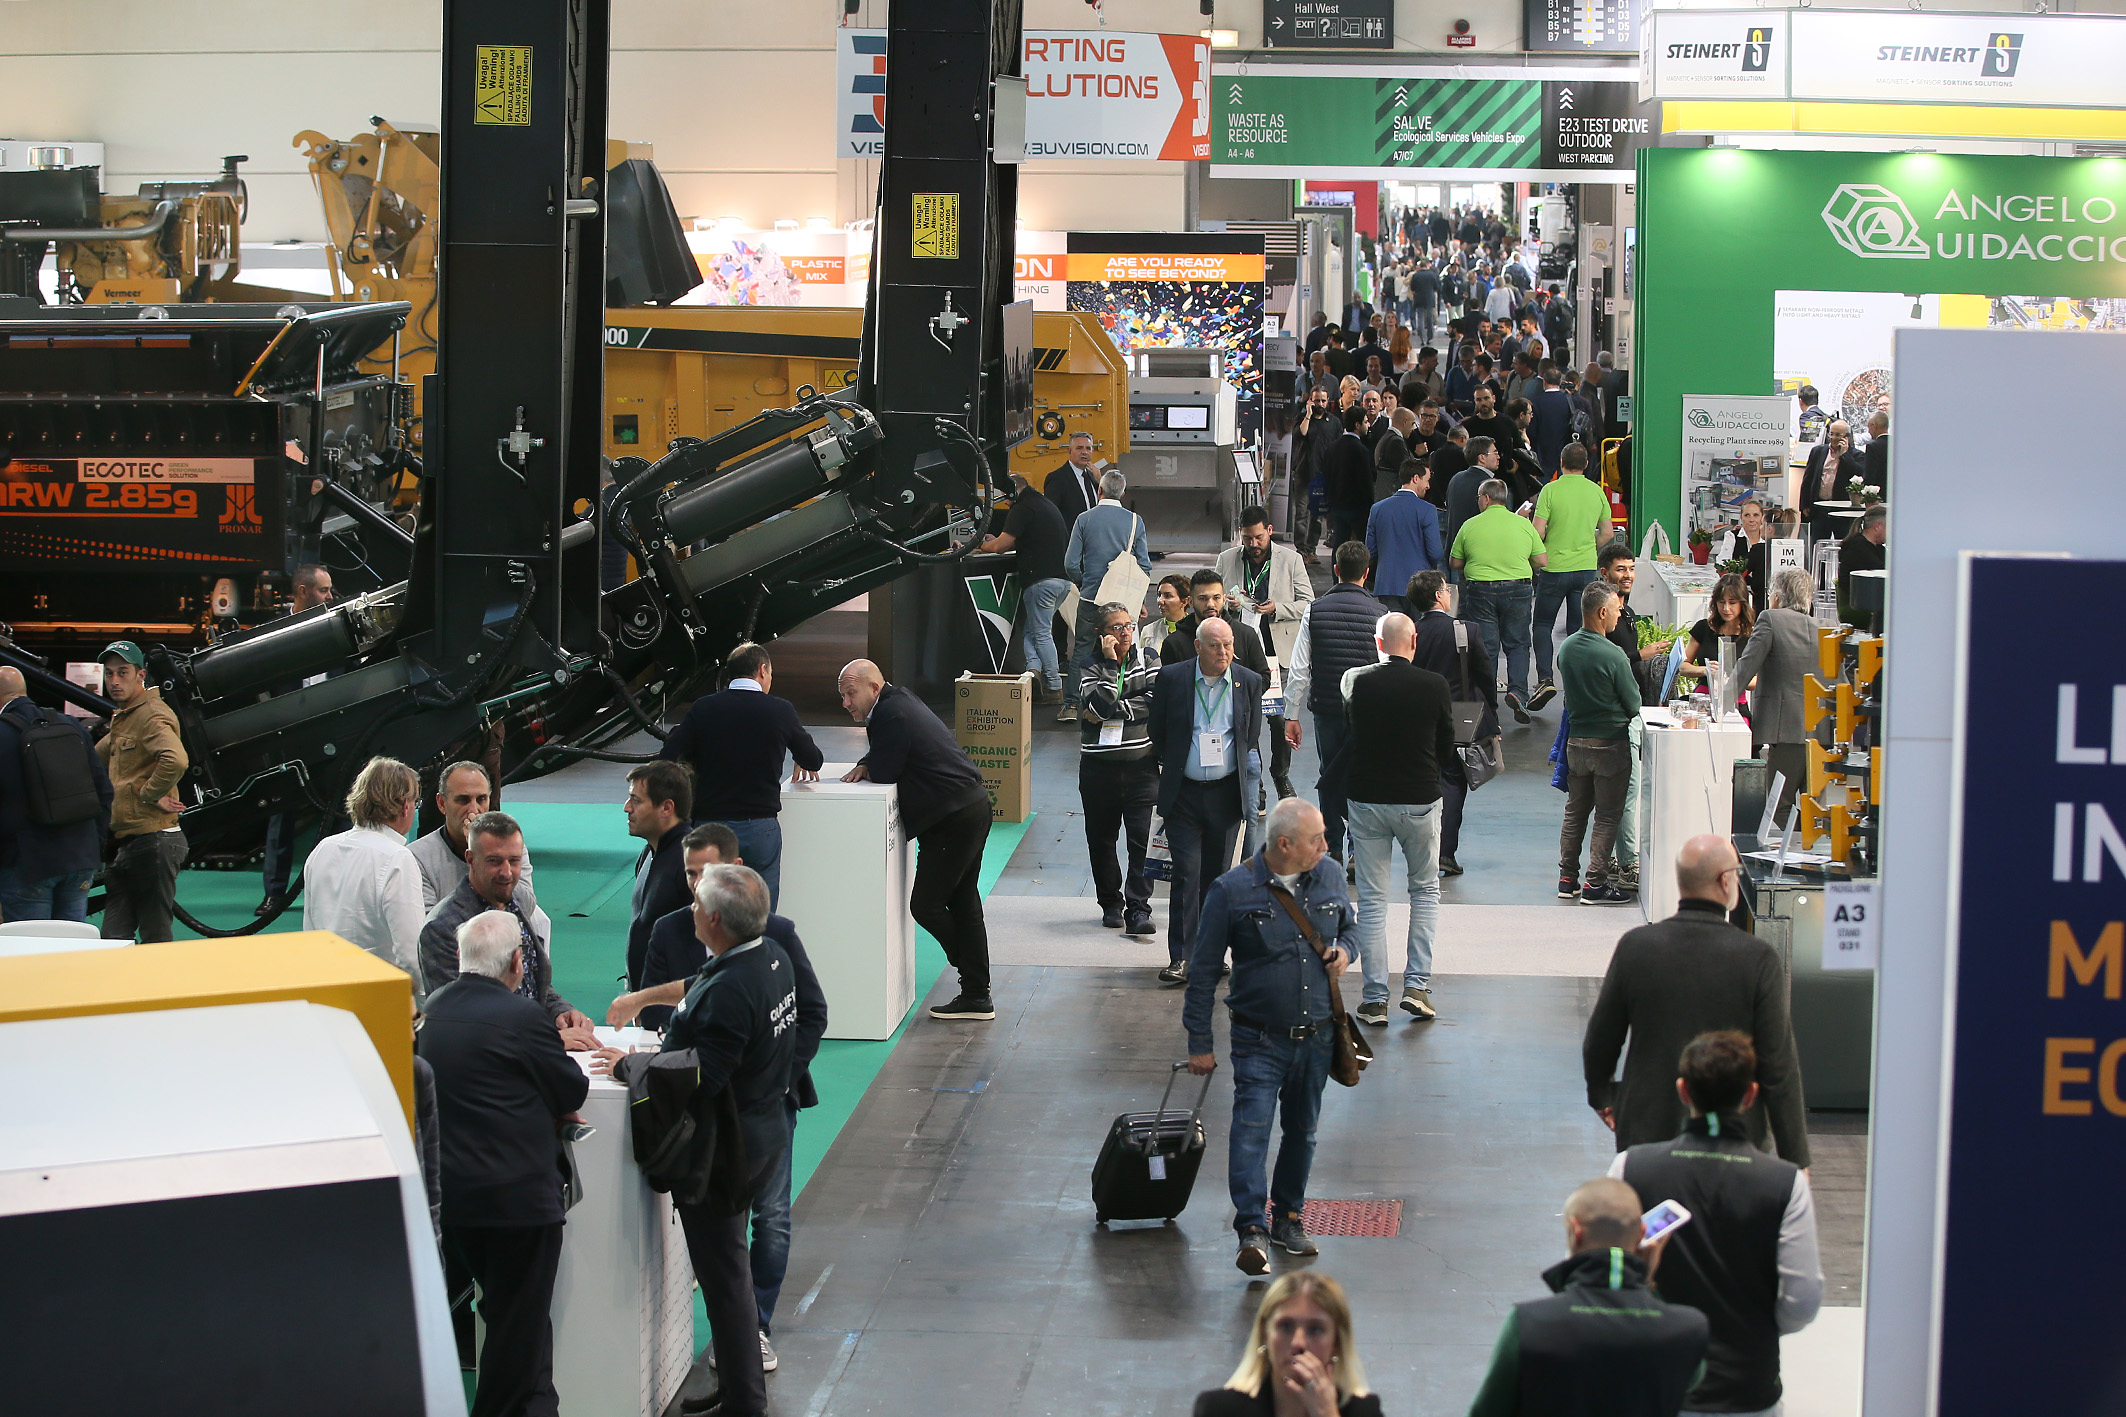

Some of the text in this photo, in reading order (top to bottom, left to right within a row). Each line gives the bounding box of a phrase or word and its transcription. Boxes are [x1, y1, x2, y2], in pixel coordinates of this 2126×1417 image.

[1295, 3, 1339, 13] Hall West
[1547, 10, 1560, 20] B3
[1617, 11, 1630, 20] D3
[1296, 20, 1315, 28] EXIT
[1547, 21, 1560, 31] B5
[1617, 21, 1630, 31] D5
[1547, 32, 1560, 42] B7
[1617, 33, 1630, 42] D7
[1025, 38, 1126, 63] RTING
[1667, 43, 1741, 59] STEINERT
[1876, 45, 1981, 63] STEINERT
[480, 56, 489, 89] Uwaga!
[489, 49, 499, 89] Warning!
[1916, 78, 1942, 86] SENSOR
[1943, 79, 1973, 87] SORTING
[1228, 113, 1285, 128] WASTE AS
[1393, 115, 1432, 130] SAL.VE
[1559, 117, 1649, 133] E23 TEST DRIVE
[1228, 129, 1288, 143] RESOURCE
[1393, 131, 1525, 144] Ecological Services Vehicles Expo
[1558, 133, 1613, 148] OUTDOOR
[1228, 148, 1238, 158] A4
[1244, 148, 1255, 158] A6
[1393, 150, 1414, 161] A7/C7
[1558, 153, 1614, 164] WEST PARKING
[1933, 187, 2117, 224] ANGELO
[923, 196, 931, 230] Warning!
[791, 259, 842, 269] PLASTIC
[1106, 257, 1224, 268] ARE YOU READY
[805, 272, 828, 281] MIX
[1104, 268, 1227, 279] TO SEE BEYOND?
[104, 289, 141, 297] Vermeer
[1716, 410, 1763, 419] ANGELO
[1716, 421, 1785, 431] UIDACCIOLU
[1688, 435, 1784, 447] Recycling Plant since 1989
[83, 462, 165, 479] ECOTEC
[86, 483, 198, 515] 2.85g
[219, 524, 262, 534] PRONAR
[1782, 548, 1794, 556] IM
[1780, 558, 1797, 567] PIA
[966, 708, 999, 716] ITALIAN
[966, 716, 1014, 724] EXHIBITION
[961, 745, 1018, 756] ORGANIC
[1833, 904, 1865, 922] A3
[1837, 928, 1860, 937] STAND
